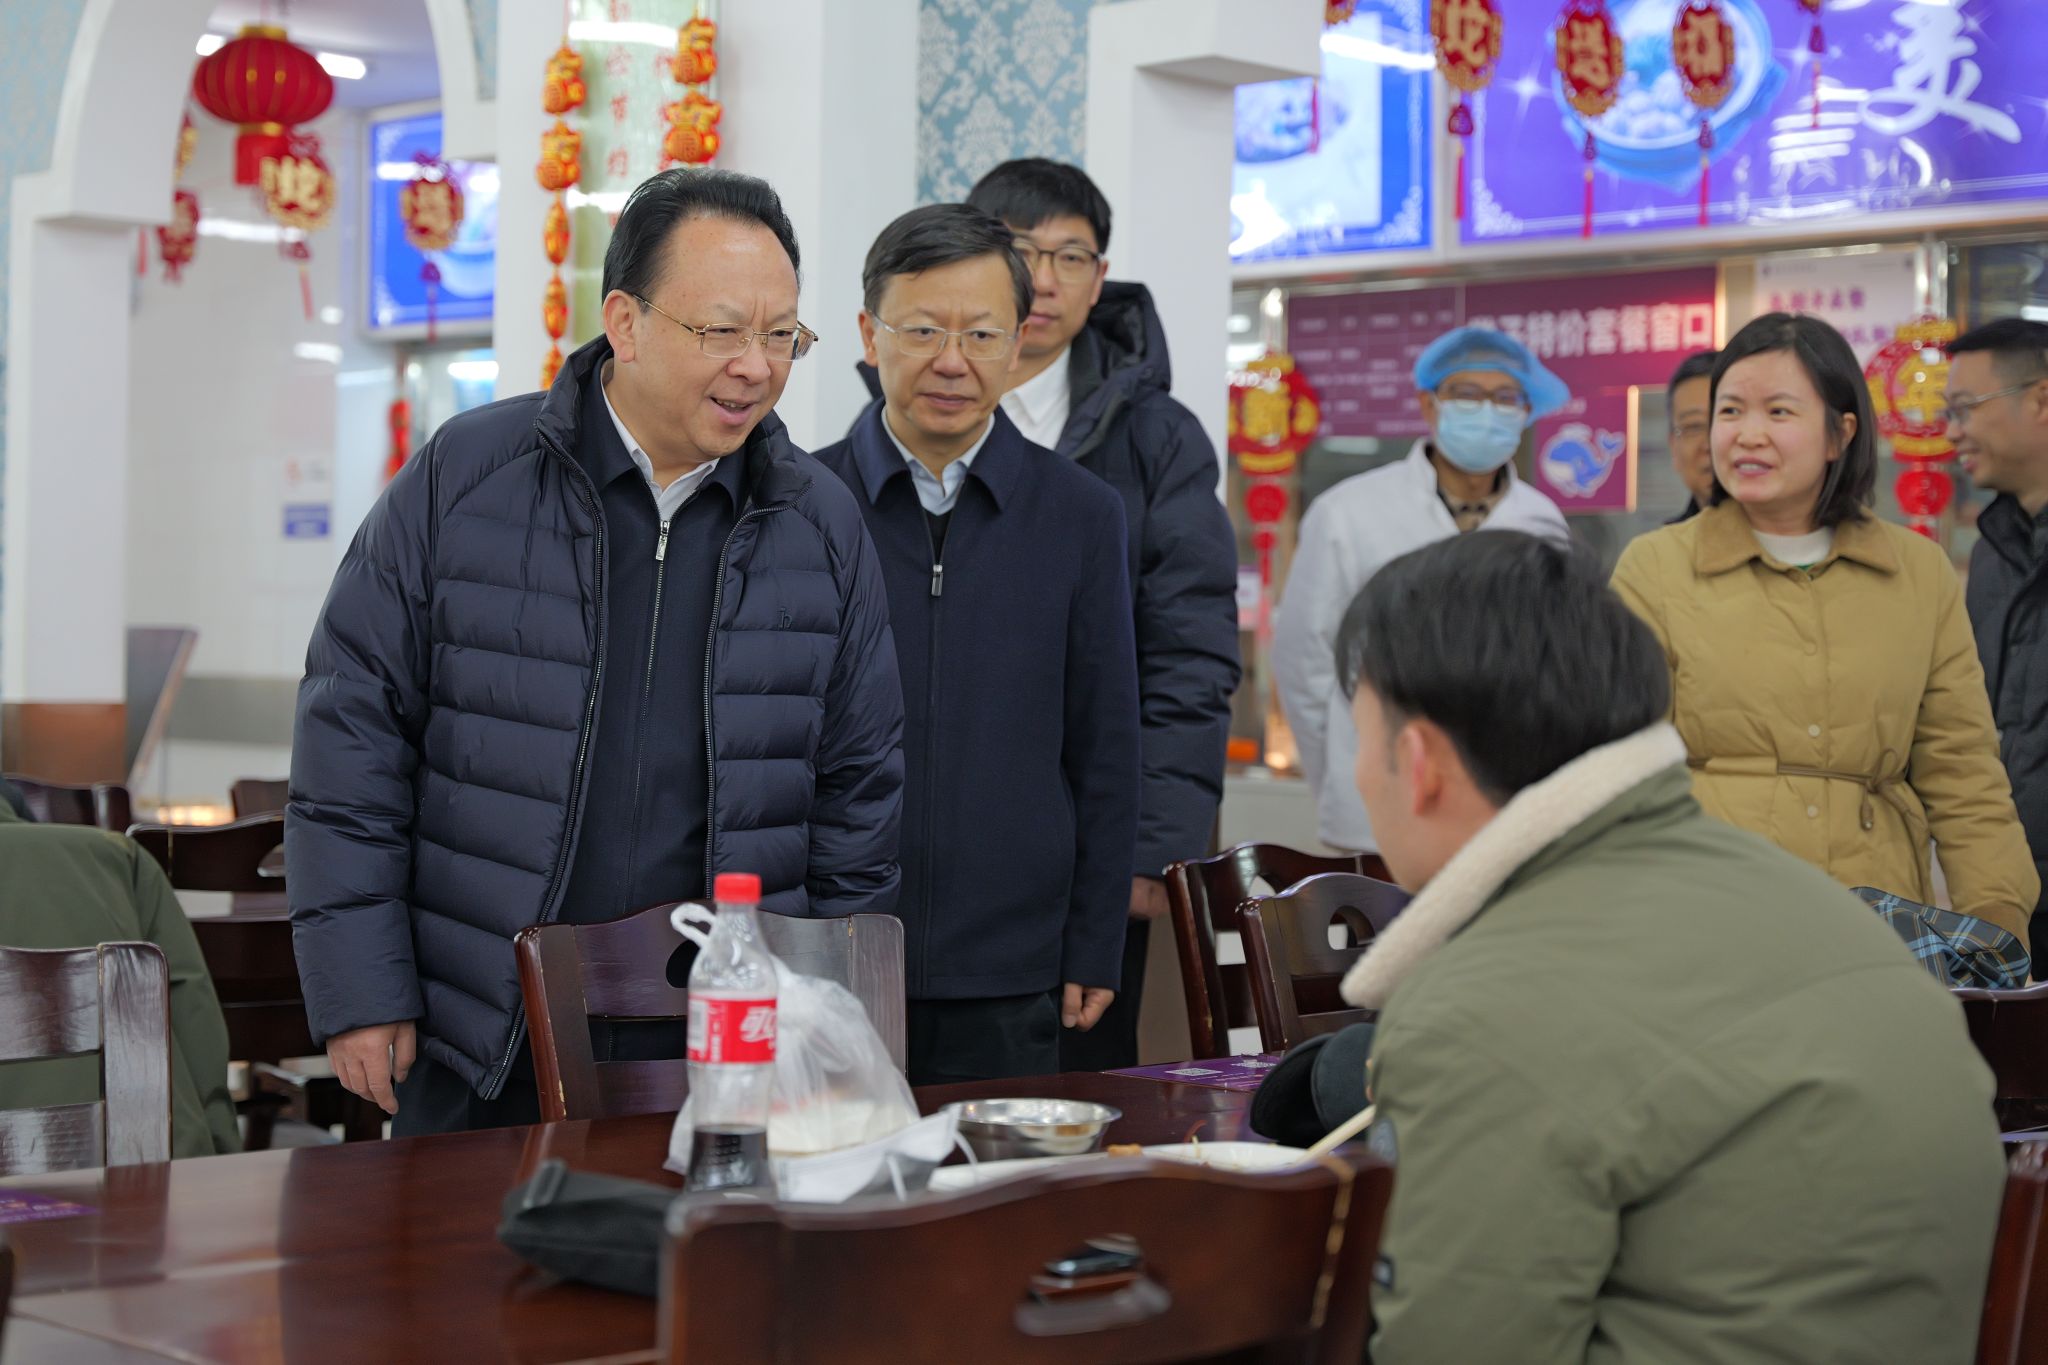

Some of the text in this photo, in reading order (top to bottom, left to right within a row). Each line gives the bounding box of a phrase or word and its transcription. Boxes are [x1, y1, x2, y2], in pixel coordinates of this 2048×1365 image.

[1470, 303, 1714, 358] 特价套餐窗口
